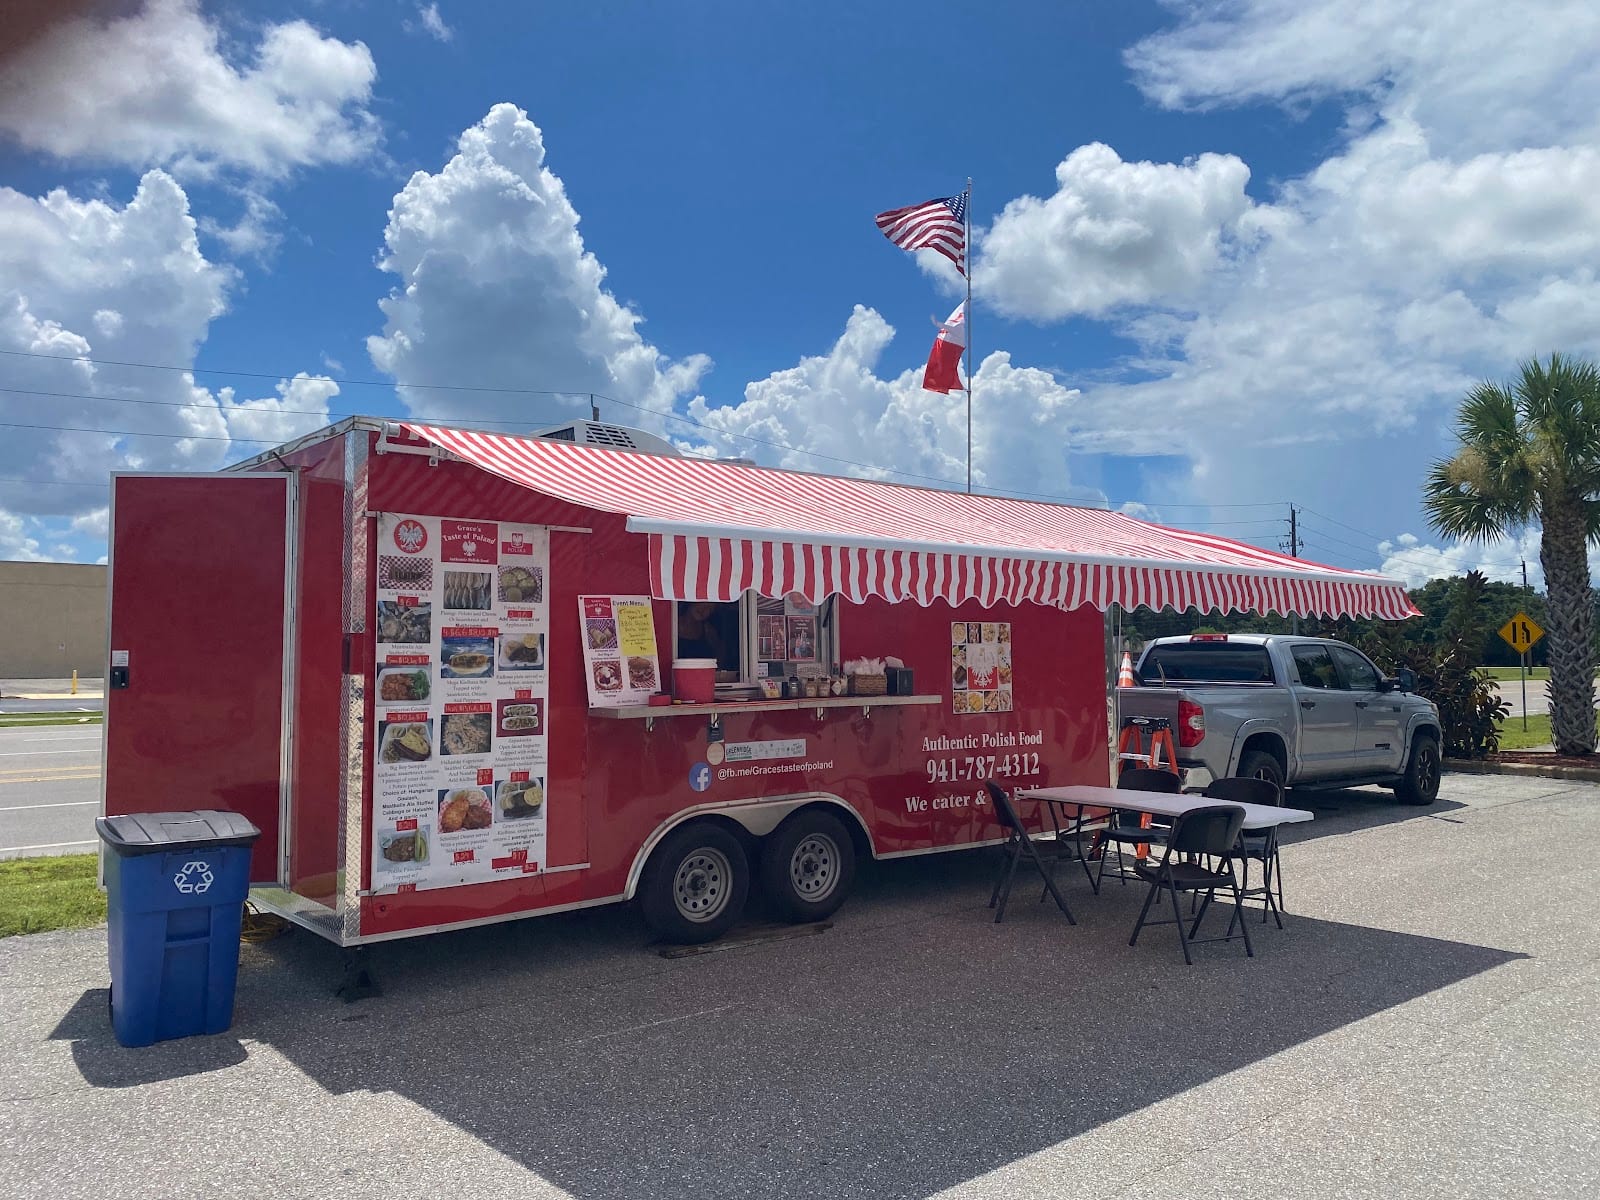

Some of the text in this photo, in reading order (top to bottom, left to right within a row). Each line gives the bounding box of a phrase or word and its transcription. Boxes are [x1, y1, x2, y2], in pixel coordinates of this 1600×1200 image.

[442, 532, 496, 545] Taste of Poland
[457, 524, 482, 532] Grace's
[922, 730, 1043, 752] Authentic Polish Food
[718, 760, 834, 780] @fb.me/Gracestasteofpoland
[926, 752, 1040, 784] 941-787-4312
[905, 796, 928, 813] We
[932, 794, 970, 810] cater
[974, 790, 986, 805] &
